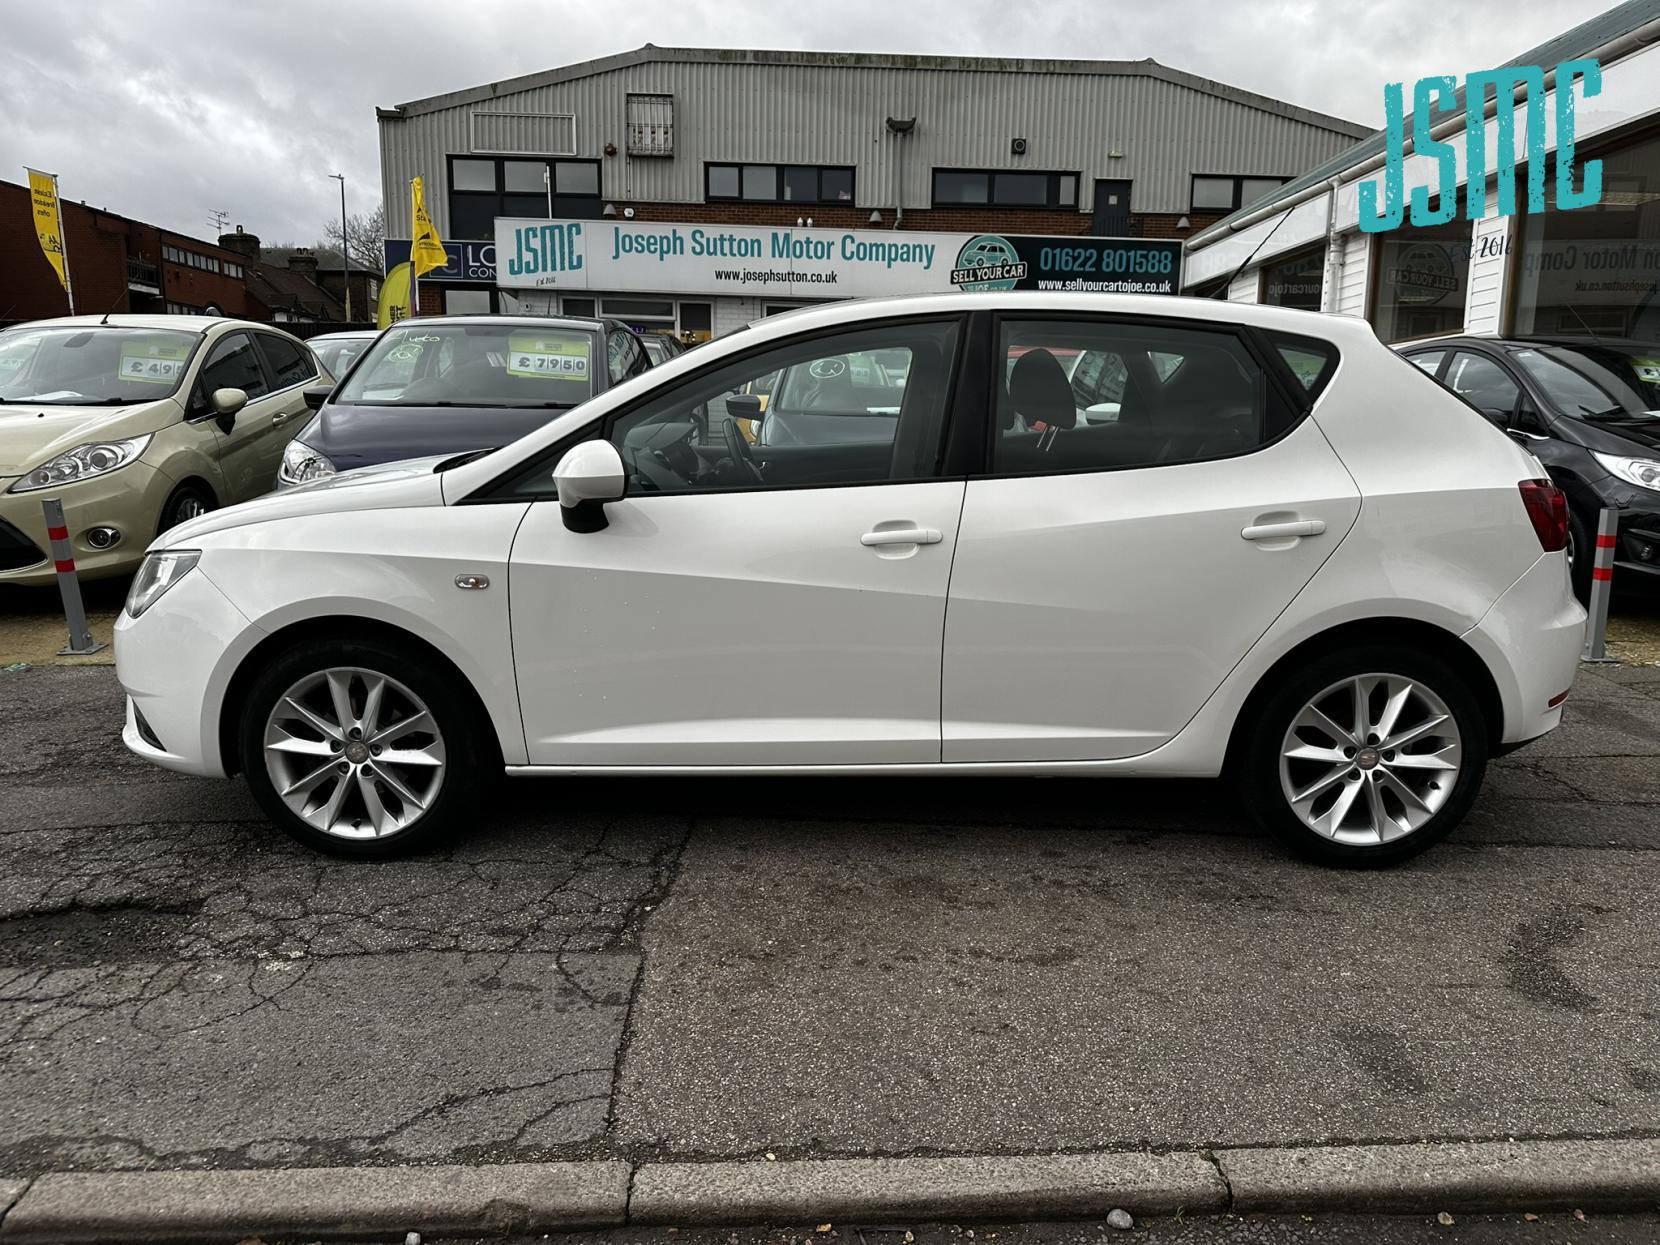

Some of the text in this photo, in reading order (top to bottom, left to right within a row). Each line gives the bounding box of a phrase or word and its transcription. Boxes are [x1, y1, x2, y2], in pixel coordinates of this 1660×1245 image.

[508, 223, 583, 276] JSMC
[613, 227, 935, 270] Joseph Sutton Motor Company
[1040, 247, 1172, 273] 01622 801588
[715, 267, 838, 285] www.josephsutton.co.uk
[952, 265, 1024, 283] SELL YOUR CAR
[1038, 278, 1172, 293] www.sellyourcartojoe.co.uk
